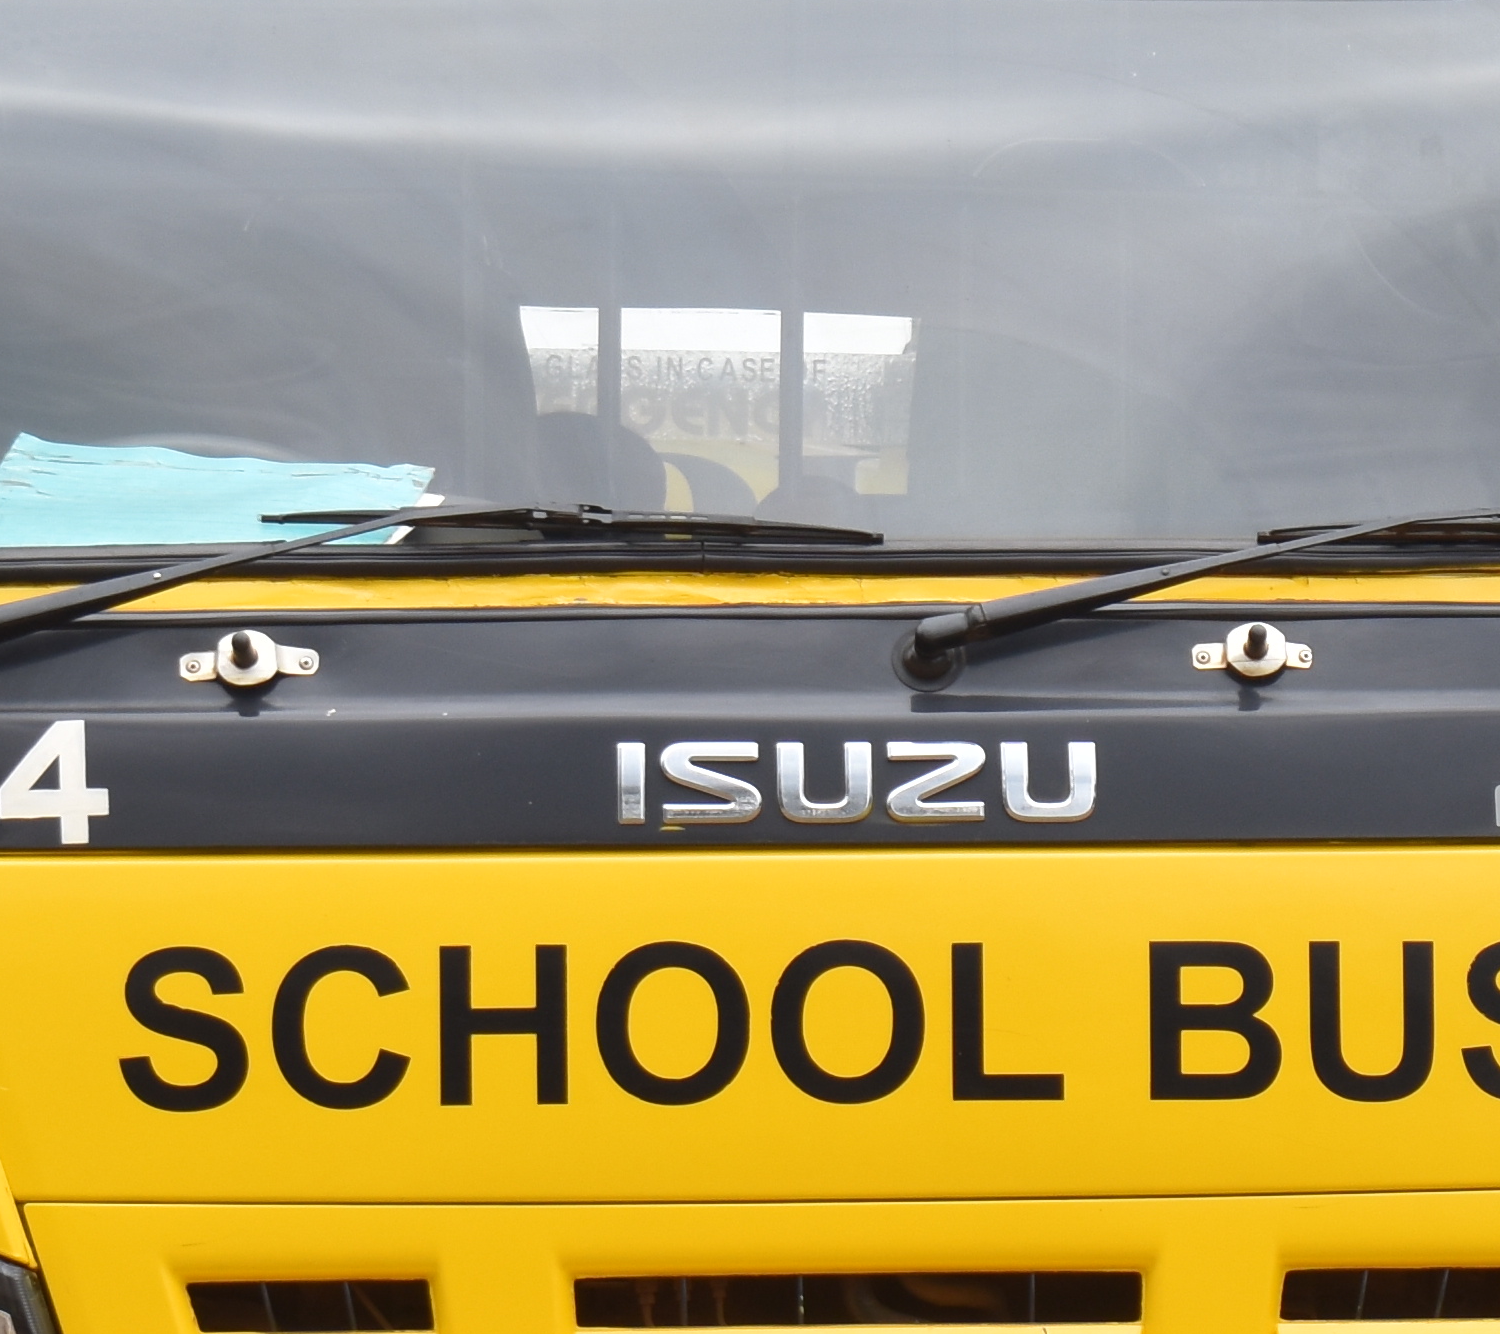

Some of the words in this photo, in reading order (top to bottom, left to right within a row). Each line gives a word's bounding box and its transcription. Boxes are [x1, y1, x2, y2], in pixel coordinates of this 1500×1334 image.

[545, 353, 643, 381] GLAS
[615, 740, 1098, 824] ISUZU
[119, 938, 1064, 1113] SCHOOL
